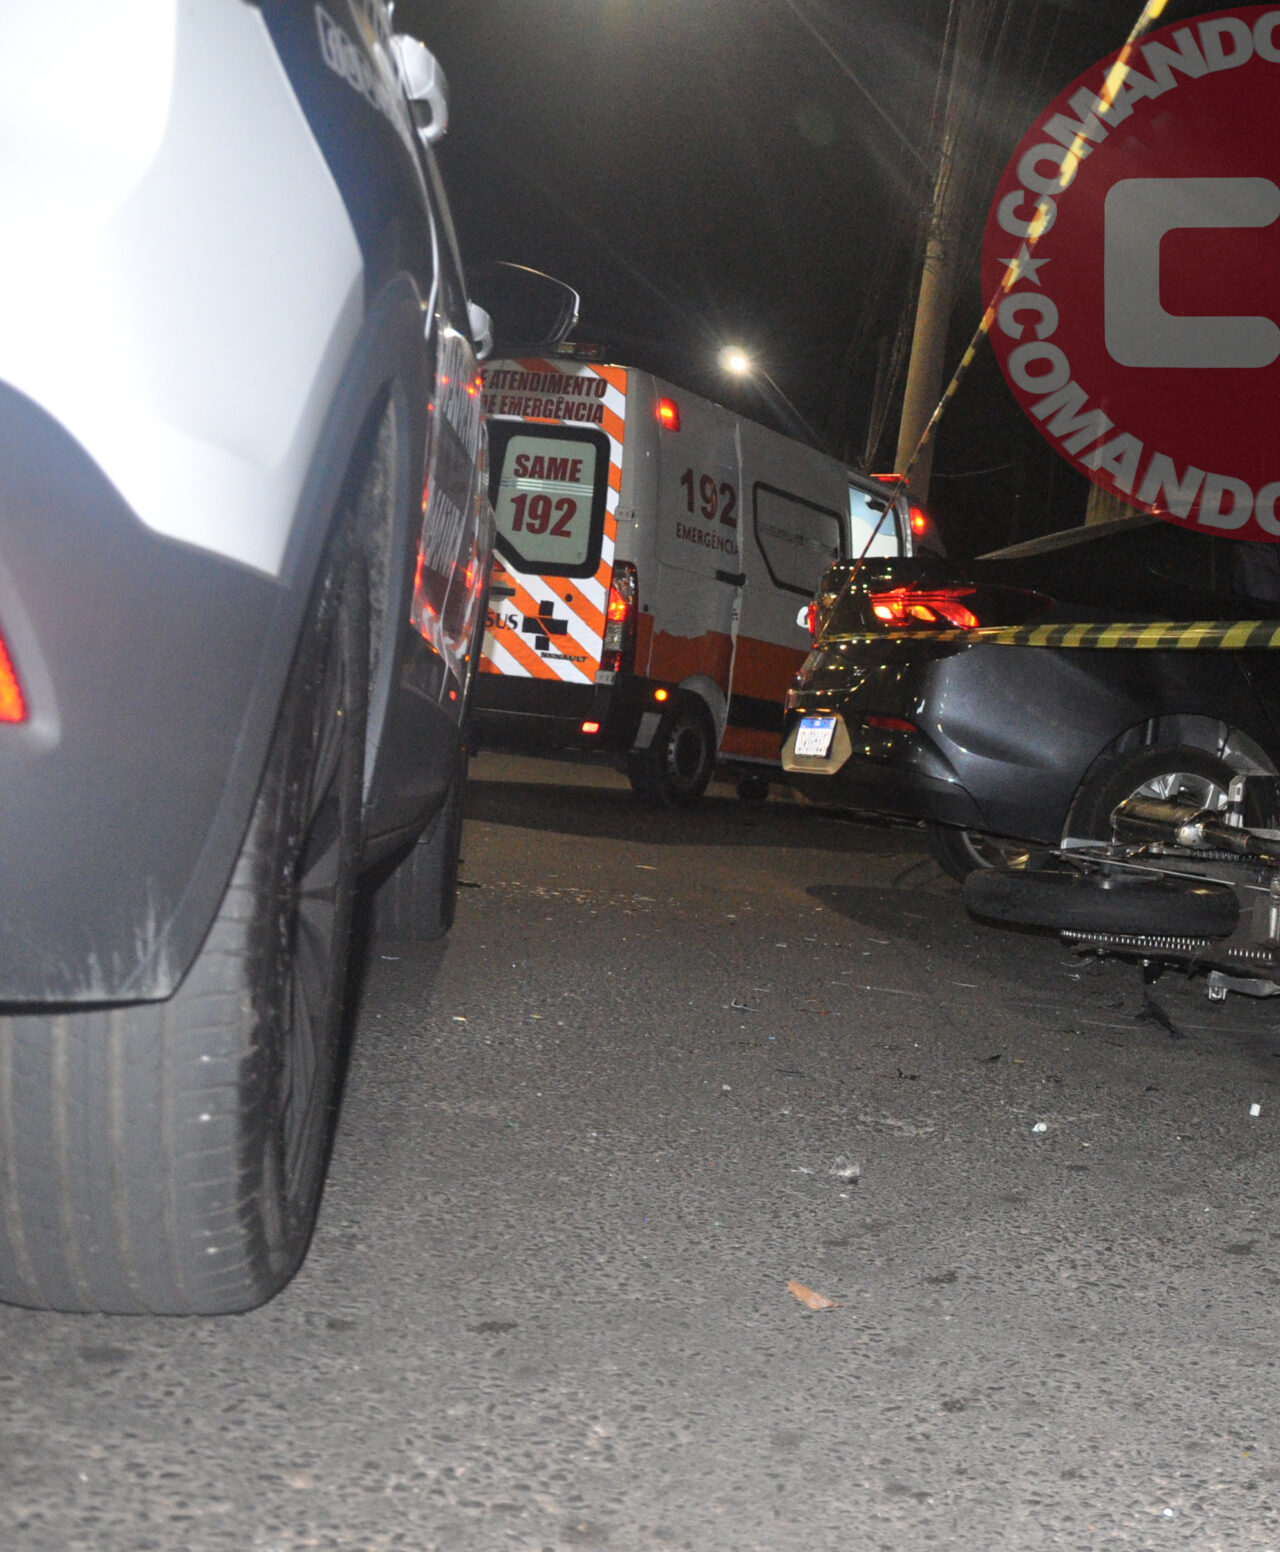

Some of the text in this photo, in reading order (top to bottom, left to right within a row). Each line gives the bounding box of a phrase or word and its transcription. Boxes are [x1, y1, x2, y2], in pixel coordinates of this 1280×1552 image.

[489, 369, 608, 399] ATENDIMENTO
[499, 395, 604, 424] EMERGÊNCIA
[513, 453, 583, 483] SAME
[680, 467, 738, 529] 192
[510, 493, 577, 538] 192
[485, 611, 519, 630] SUS
